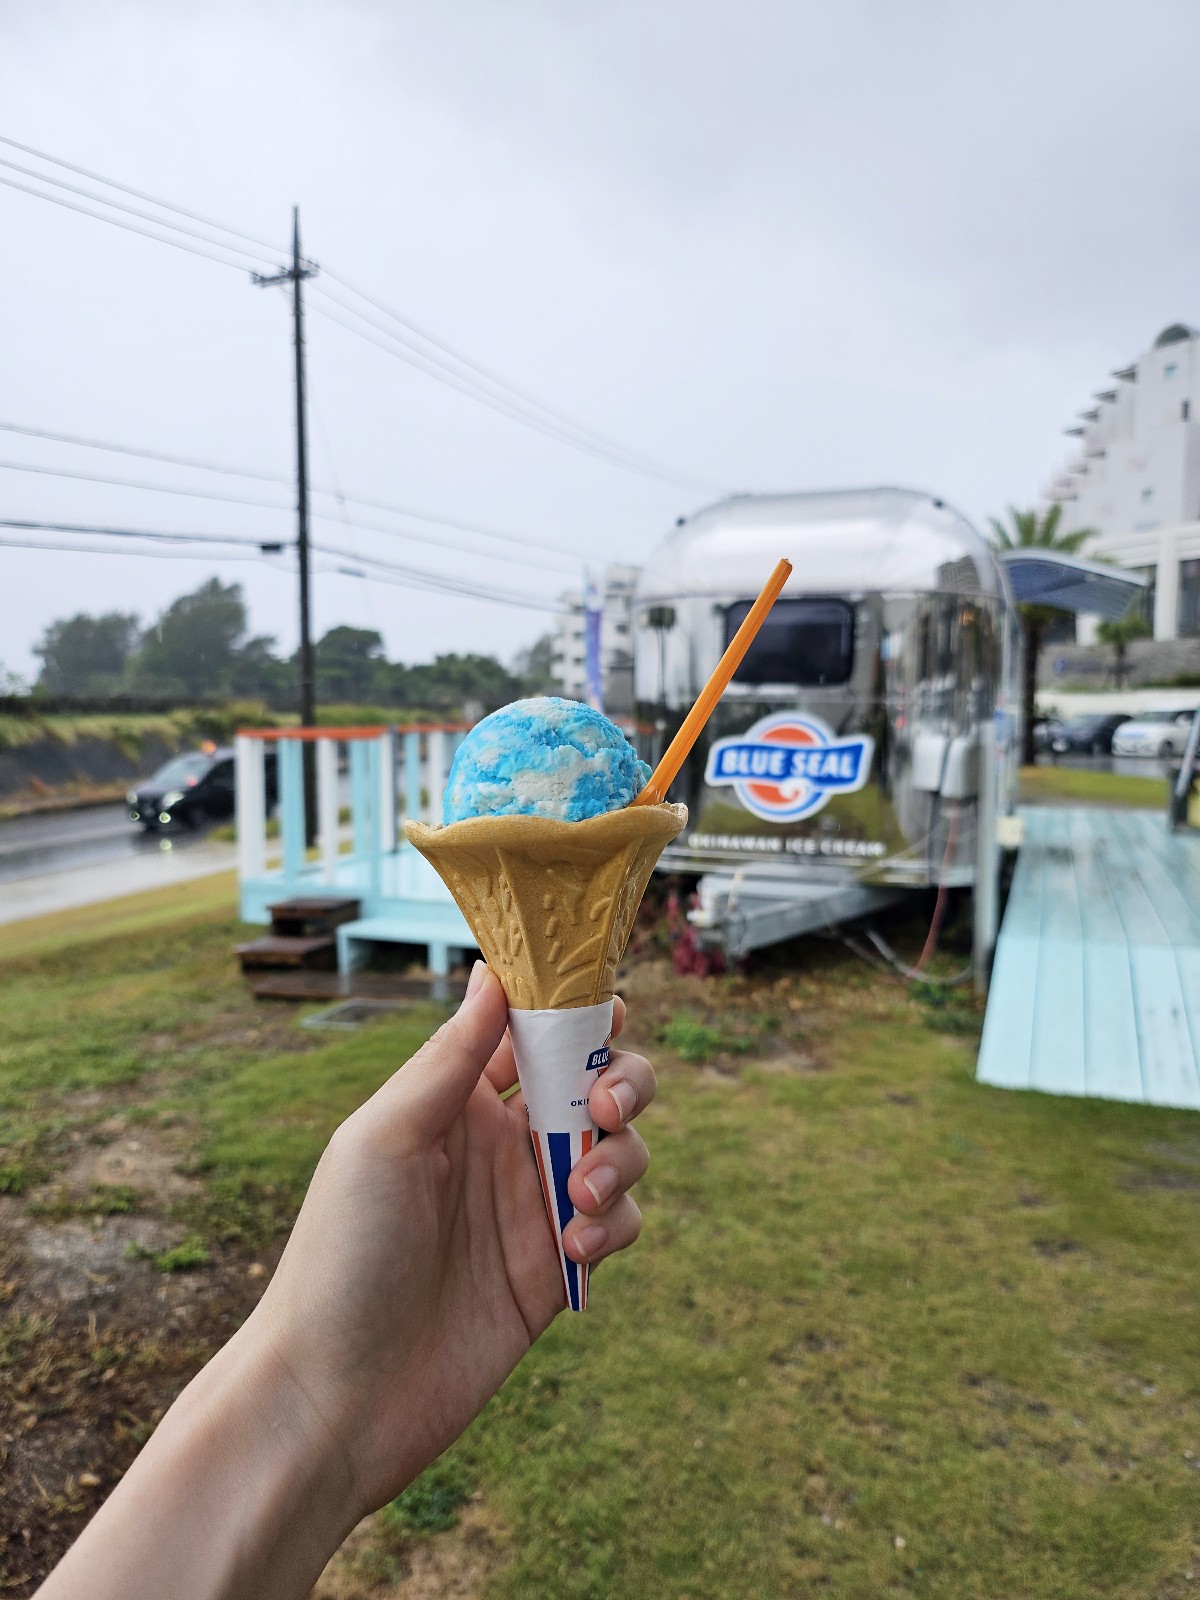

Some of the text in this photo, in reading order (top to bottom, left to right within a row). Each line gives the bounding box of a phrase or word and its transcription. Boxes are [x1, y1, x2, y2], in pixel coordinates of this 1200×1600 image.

[721, 749, 851, 779] BLUE SEAL
[785, 838, 816, 855] ICE
[820, 839, 885, 856] CREAM
[591, 1050, 609, 1066] BLU
